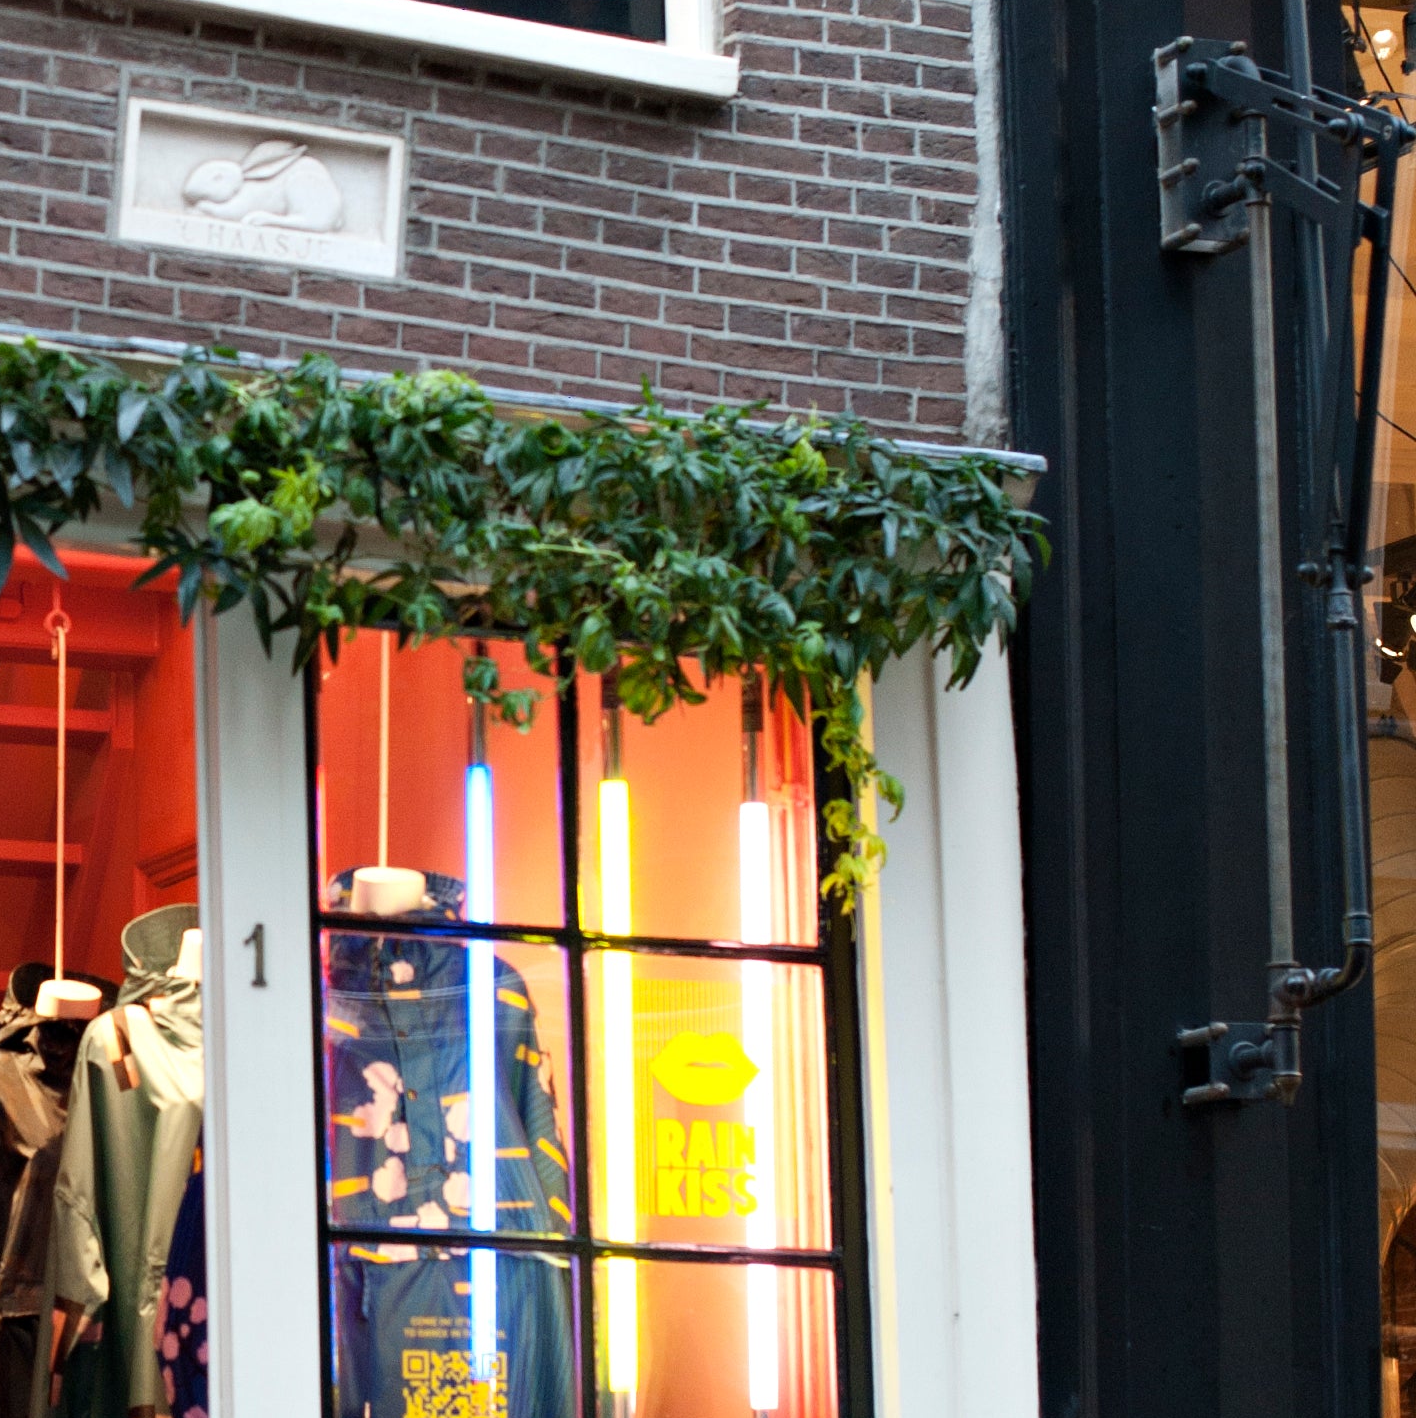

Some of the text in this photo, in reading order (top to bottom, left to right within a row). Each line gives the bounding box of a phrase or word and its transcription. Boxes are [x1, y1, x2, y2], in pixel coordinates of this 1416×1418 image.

[207, 223, 332, 265] HAASJE
[243, 922, 268, 988] 1
[656, 1118, 756, 1168] RAIN
[657, 1167, 758, 1218] KISS
